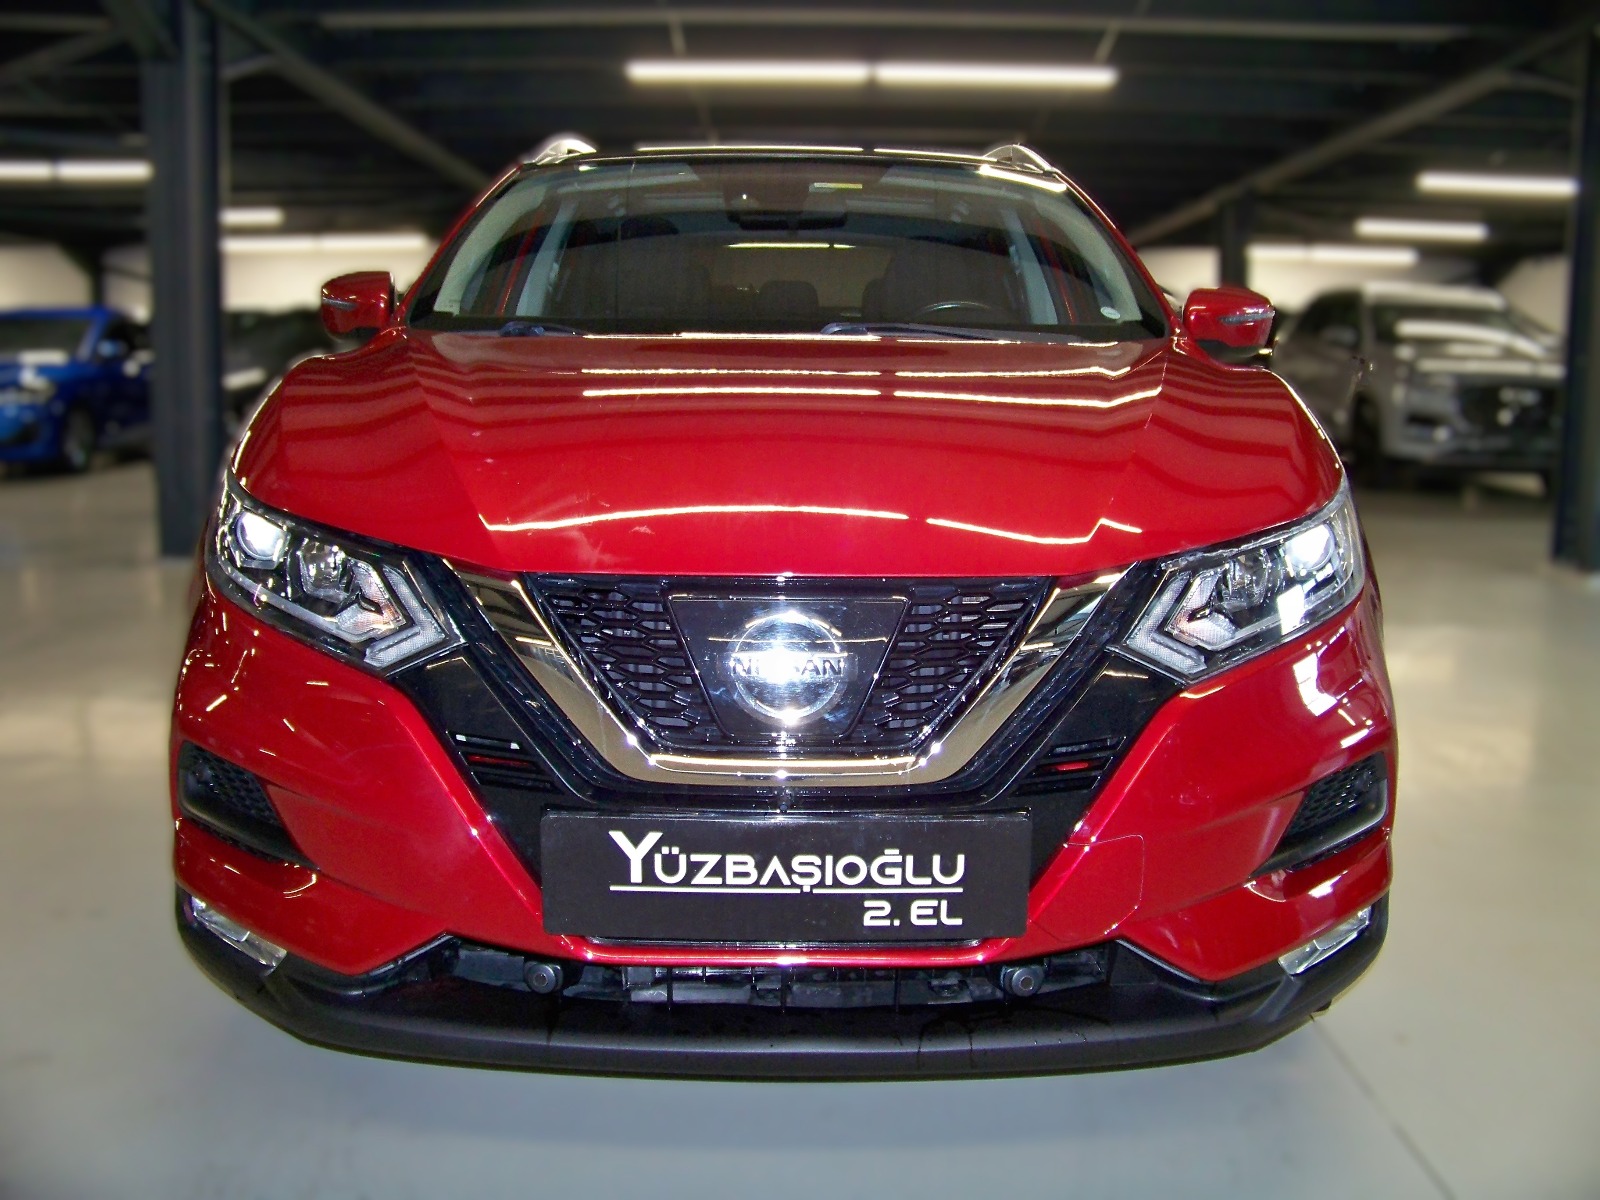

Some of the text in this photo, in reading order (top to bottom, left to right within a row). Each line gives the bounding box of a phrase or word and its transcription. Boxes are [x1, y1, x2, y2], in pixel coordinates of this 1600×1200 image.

[608, 830, 966, 893] YÜZBAŞIOĞLU
[863, 899, 964, 927] 2. EL
